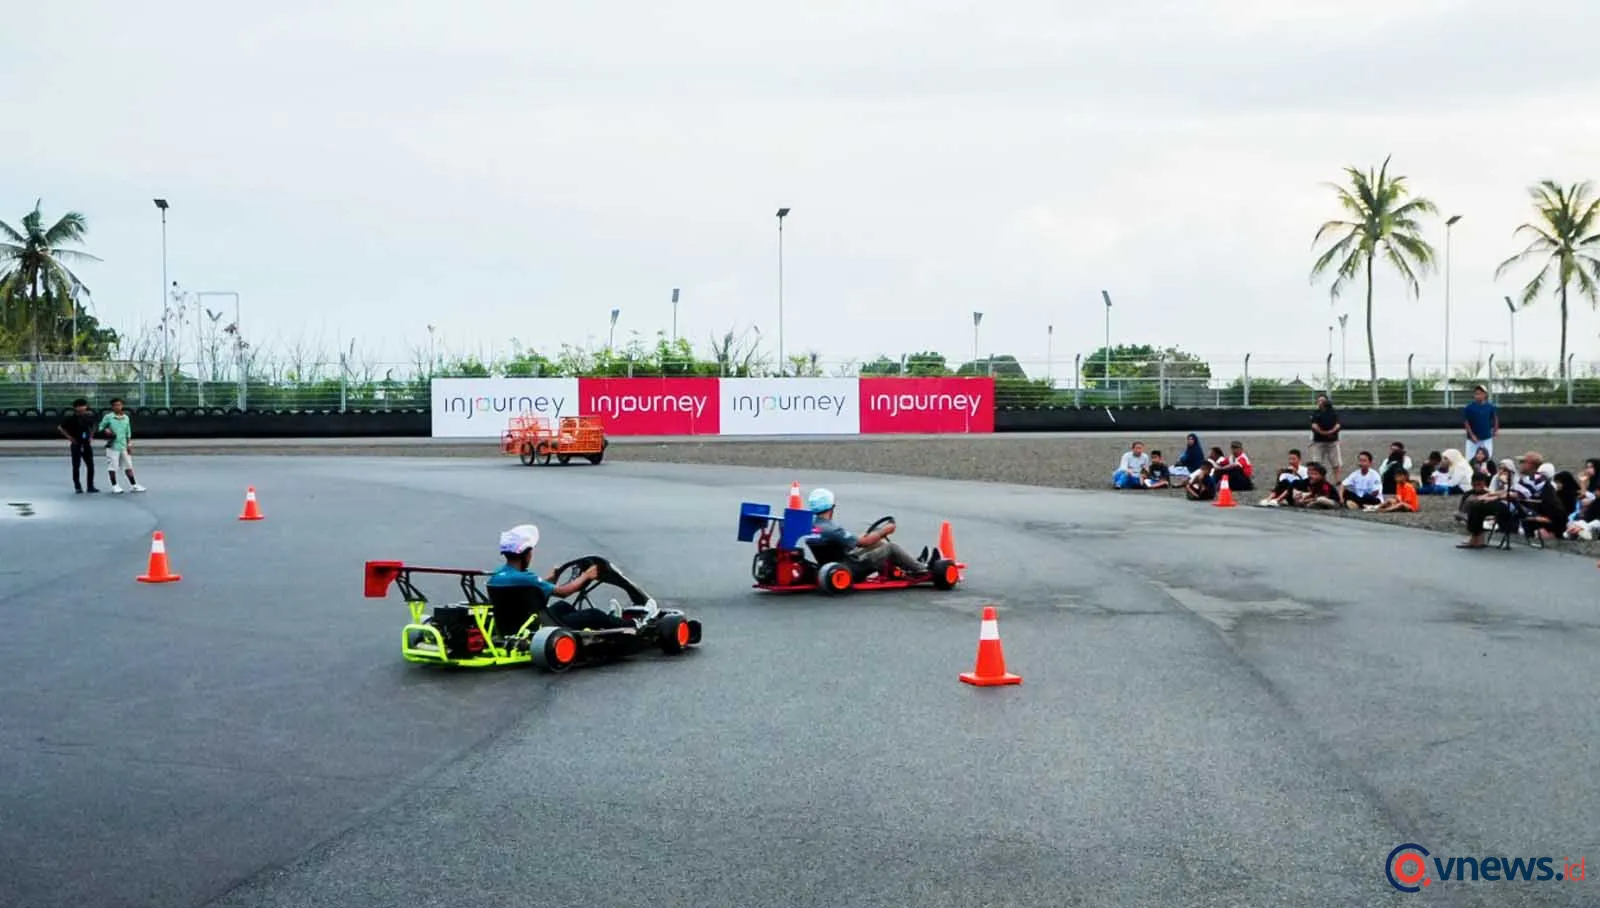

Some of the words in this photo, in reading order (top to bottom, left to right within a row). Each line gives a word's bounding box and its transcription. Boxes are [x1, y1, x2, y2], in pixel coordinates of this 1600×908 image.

[444, 395, 565, 418] injourney
[590, 395, 707, 418] injourney
[733, 395, 846, 417] injourney
[871, 394, 981, 416] injourney
